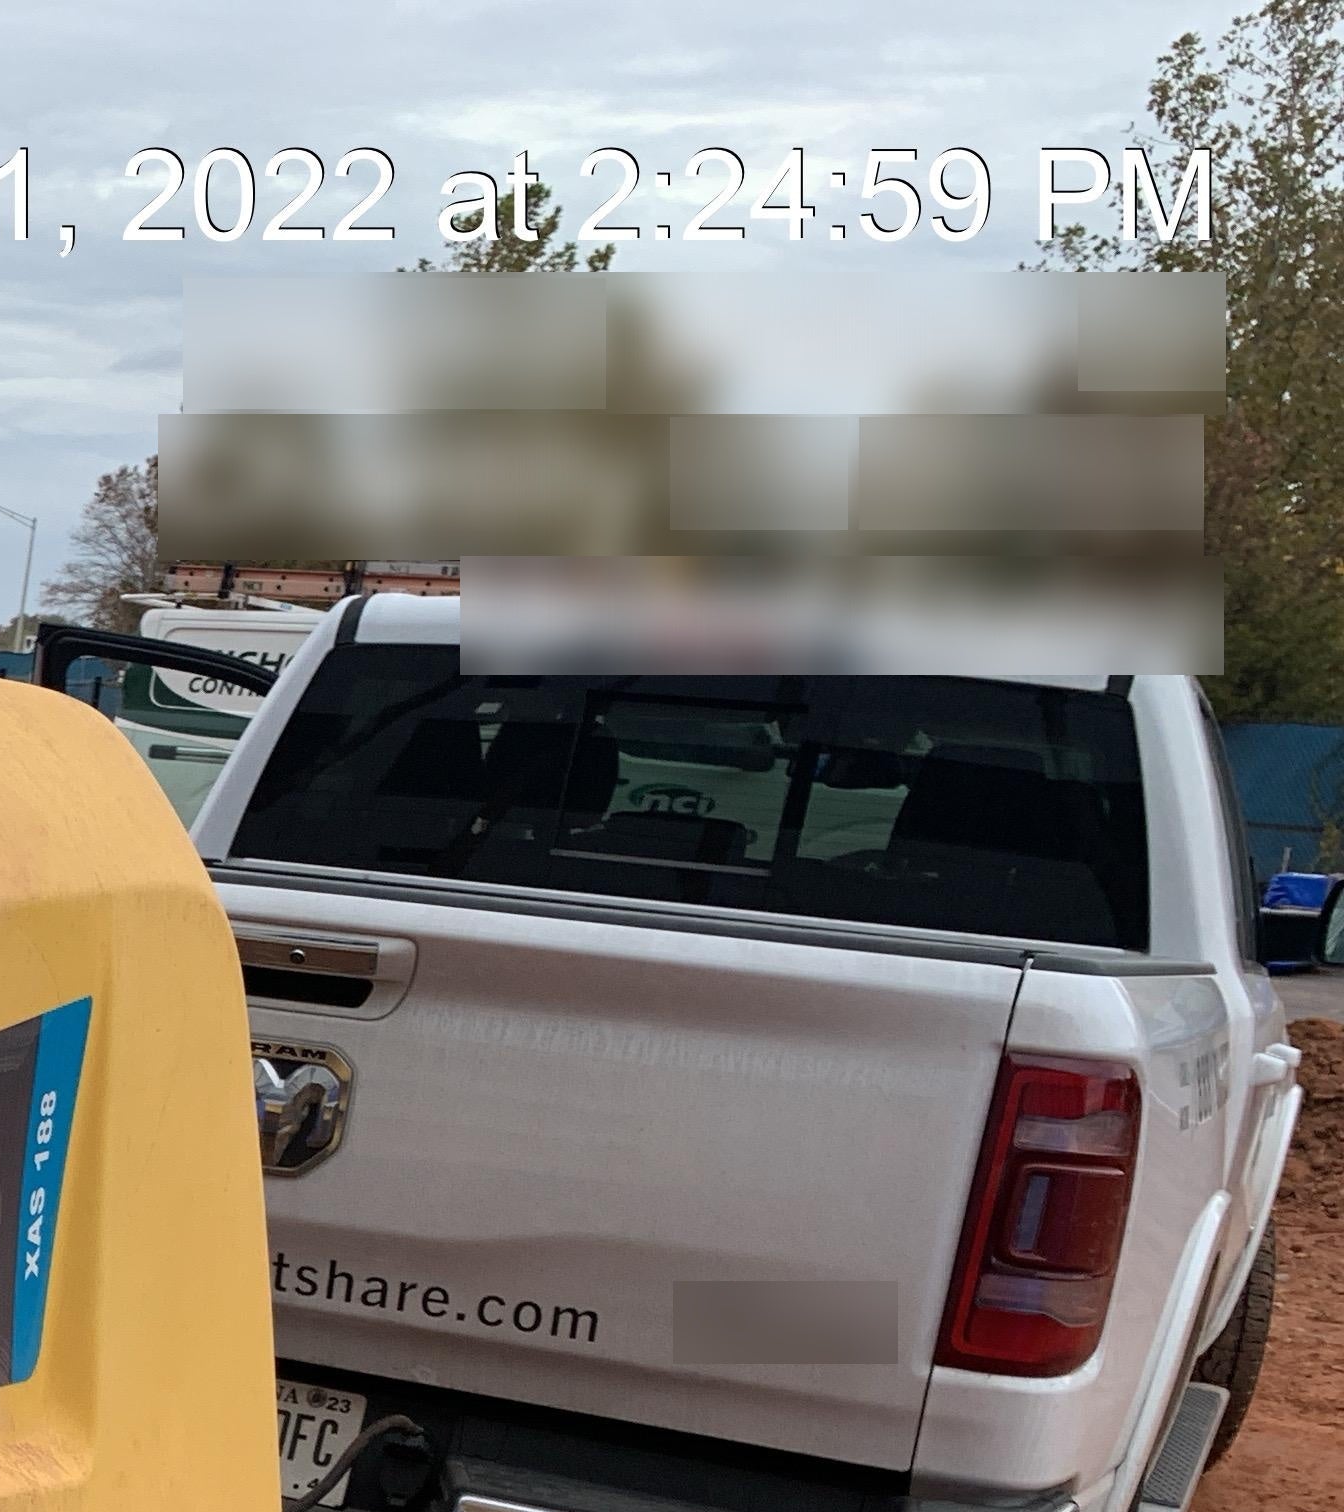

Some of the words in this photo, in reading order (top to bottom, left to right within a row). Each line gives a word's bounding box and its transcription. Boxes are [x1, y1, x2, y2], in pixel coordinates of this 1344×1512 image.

[252, 1042, 327, 1060] RAM
[34, 1090, 58, 1172] 188
[24, 1186, 46, 1281] XAS
[326, 1396, 352, 1414] 23
